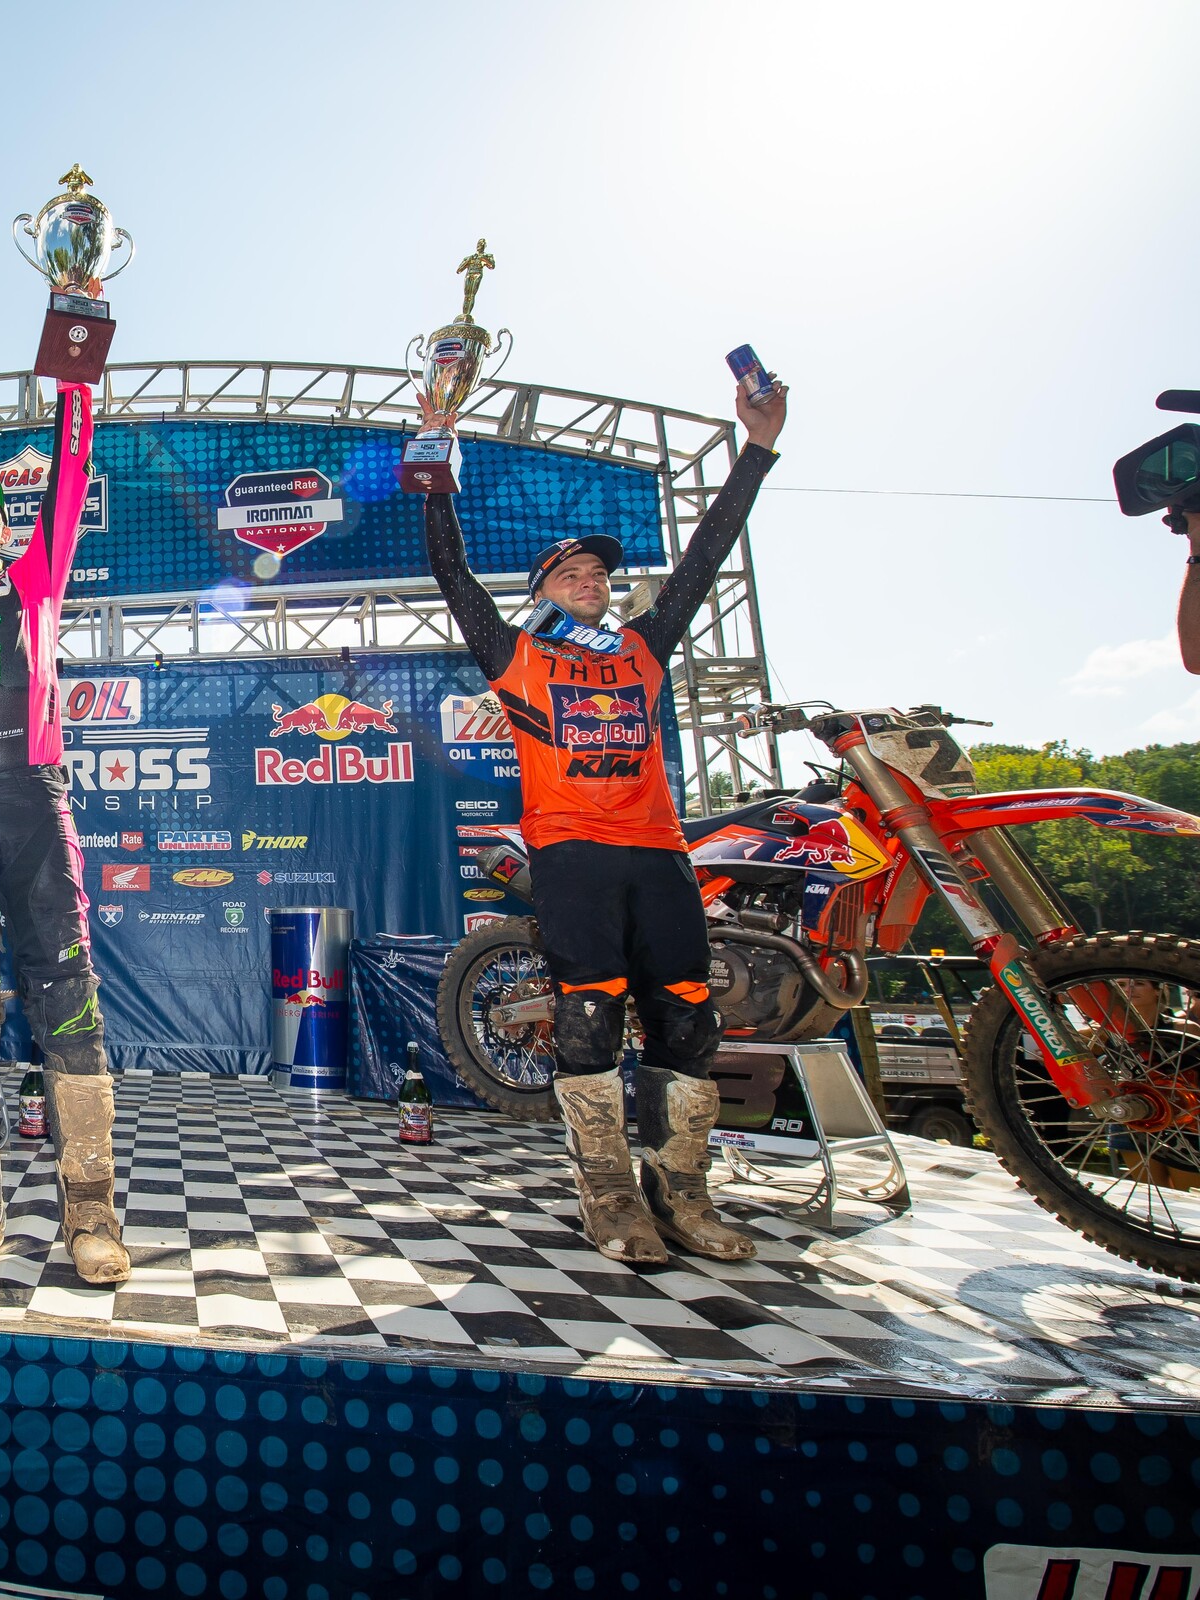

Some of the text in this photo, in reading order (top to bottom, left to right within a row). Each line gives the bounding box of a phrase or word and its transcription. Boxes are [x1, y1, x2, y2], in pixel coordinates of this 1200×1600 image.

[235, 480, 318, 496] guaranteed Rate
[246, 505, 313, 523] IRONMAN
[246, 525, 316, 536] NATIONAL
[67, 681, 132, 721] OIL
[455, 716, 513, 740] LUC
[562, 722, 646, 745] Red Bull
[449, 748, 476, 760] OIL
[63, 748, 211, 791] ROSS
[255, 742, 414, 785] Red Bull
[565, 754, 644, 778] KTM
[70, 795, 212, 810] NSHIP
[455, 801, 499, 810] GEICO
[79, 832, 143, 848] anteed Rate
[158, 831, 231, 843] PARTS
[256, 836, 308, 849] THOR
[158, 842, 231, 850] UNLIMITED
[173, 871, 234, 884] FMF
[274, 872, 336, 883] SUZUKI
[804, 883, 831, 895] KTM
[105, 911, 117, 923] X
[150, 912, 206, 921] DUNLOP
[230, 913, 239, 924] 2
[220, 926, 250, 934] RECOVERY
[273, 968, 344, 989] Red Bull
[1014, 986, 1072, 1056] MOTOREX
[293, 1066, 314, 1075] Vitalizes
[771, 1118, 804, 1133] RD
[710, 1137, 756, 1148] MOTOCROSS
